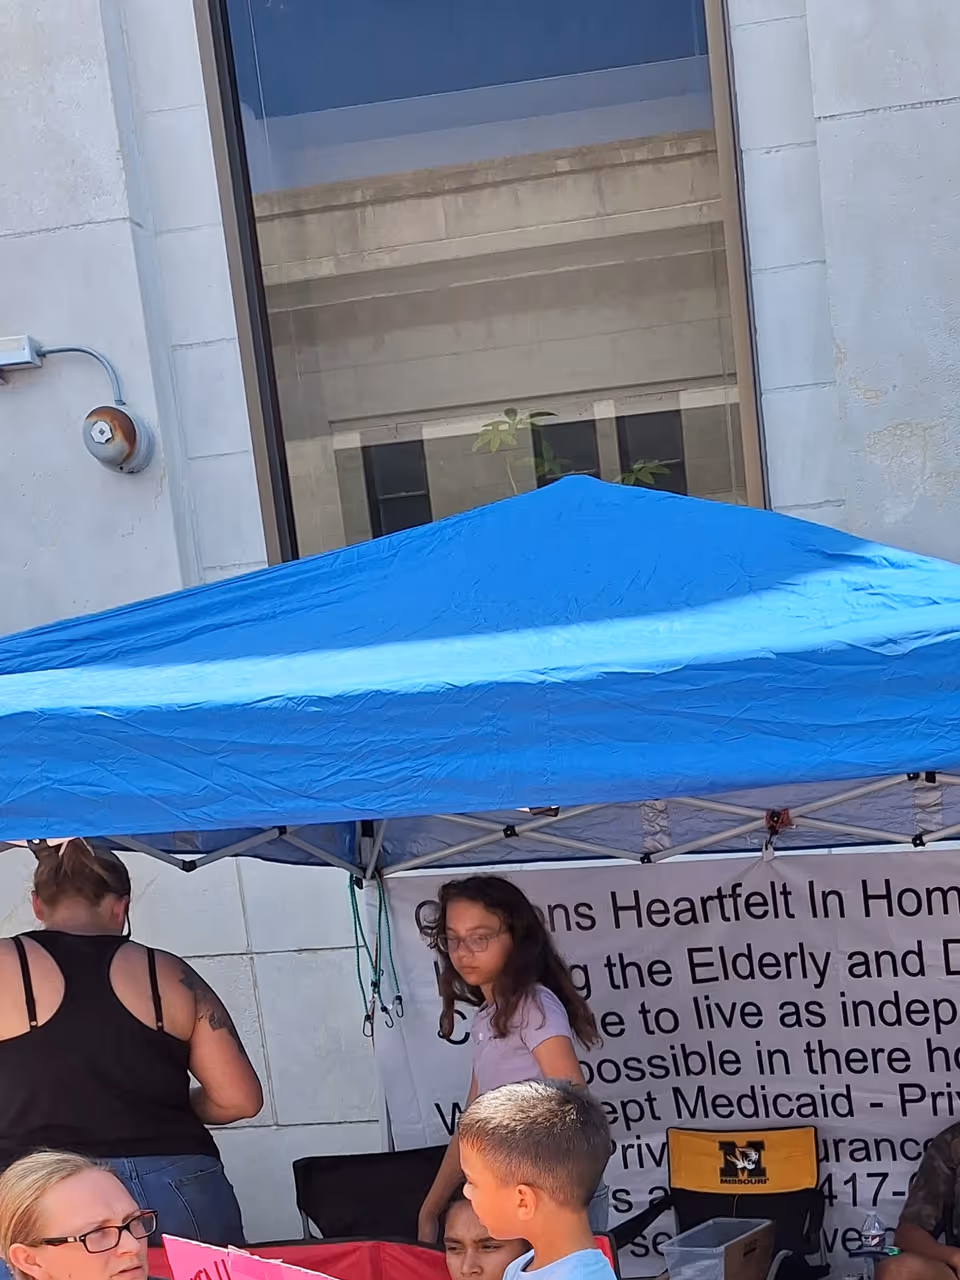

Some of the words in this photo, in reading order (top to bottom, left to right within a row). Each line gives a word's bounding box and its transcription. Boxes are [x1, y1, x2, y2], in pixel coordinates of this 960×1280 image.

[610, 880, 796, 929] Heartfelt
[808, 880, 846, 918] In
[604, 952, 673, 990] the
[687, 942, 831, 990] Elderly
[848, 939, 926, 979] and
[638, 1001, 680, 1035] to
[692, 994, 764, 1030] live
[778, 999, 827, 1029] as
[755, 1039, 791, 1075] in
[803, 1039, 911, 1075] there
[601, 1090, 662, 1131] ept
[672, 1084, 855, 1120] Medicaid
